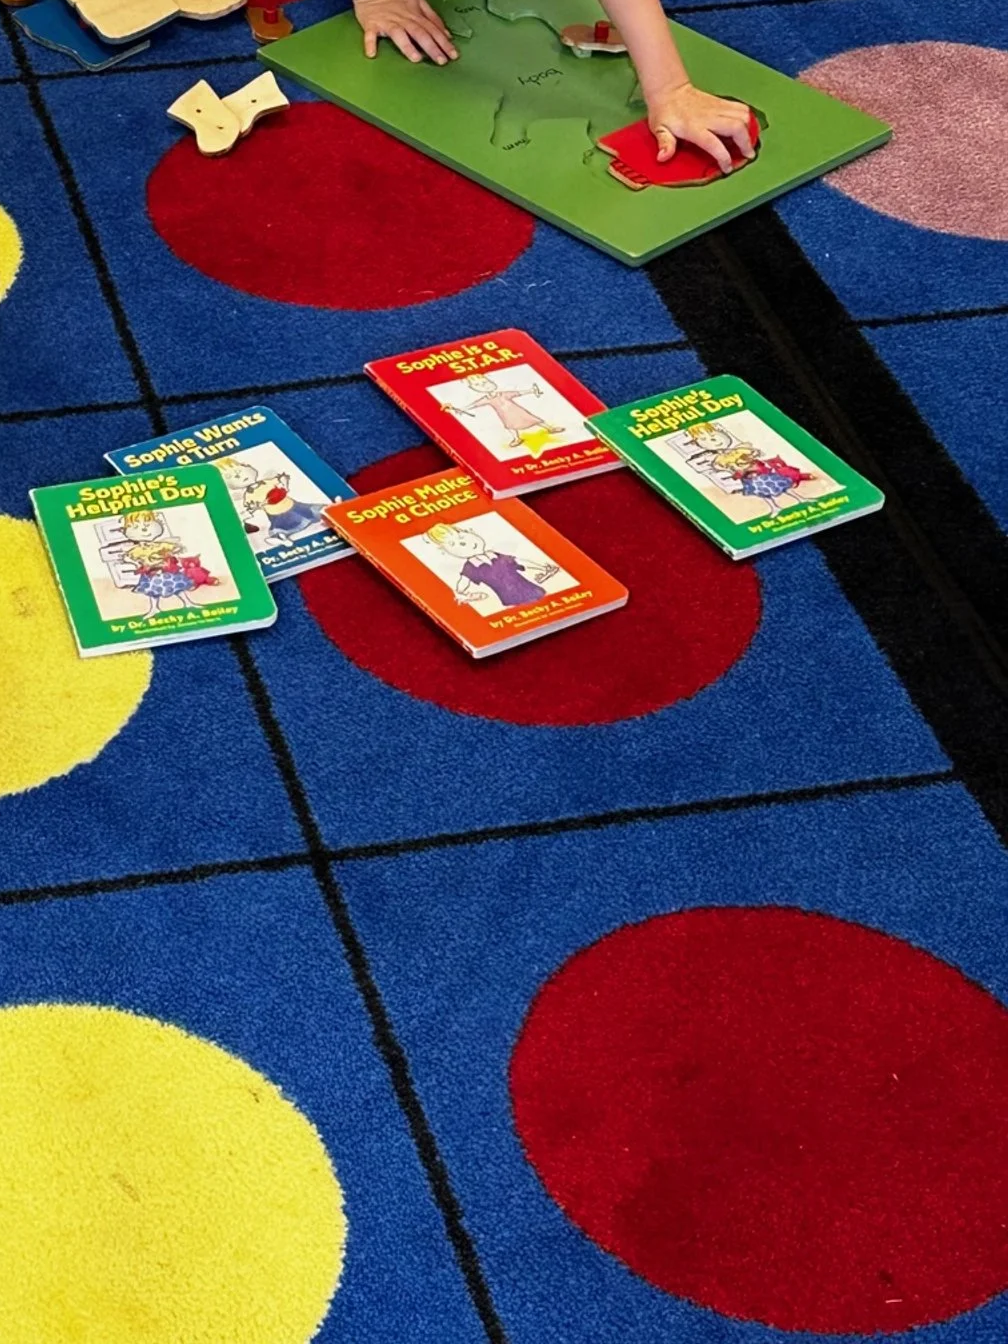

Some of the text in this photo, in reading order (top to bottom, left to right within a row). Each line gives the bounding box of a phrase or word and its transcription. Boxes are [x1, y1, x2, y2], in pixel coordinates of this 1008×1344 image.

[396, 340, 499, 375] Sophie is a
[448, 347, 524, 374] S.T.A.R.
[628, 392, 744, 439] Helpful Day
[629, 389, 714, 425] Sophie's
[124, 412, 267, 468] Sophie Wants
[177, 436, 241, 465] a Turn
[65, 483, 208, 520] Helpful Day
[79, 474, 178, 502] Sophie's
[346, 494, 417, 525] Sophie
[395, 490, 479, 524] a Choice
